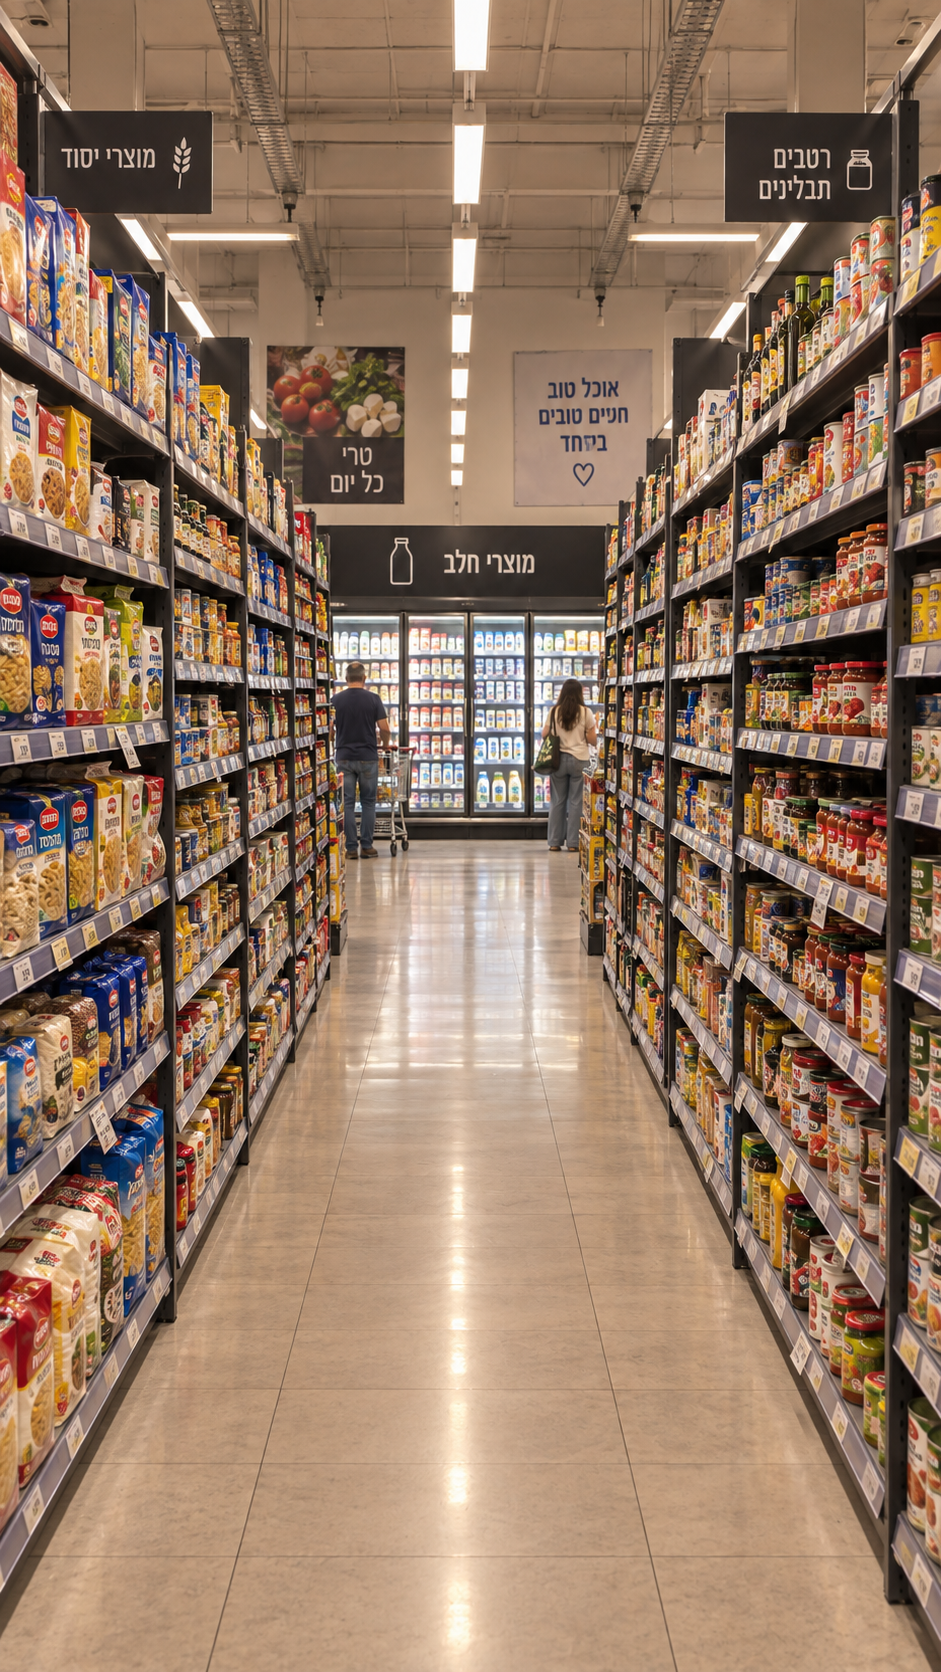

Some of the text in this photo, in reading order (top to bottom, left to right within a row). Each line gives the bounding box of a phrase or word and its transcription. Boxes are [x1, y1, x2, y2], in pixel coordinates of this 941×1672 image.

[60, 147, 156, 169] מוצרי יסוד
[773, 148, 831, 170] רטבים
[758, 174, 831, 200] תבלינים
[547, 376, 619, 399] אוכל טוב
[538, 407, 583, 426] טובים
[342, 446, 373, 466] טרי
[330, 469, 384, 494] כל יום
[443, 548, 535, 574] מוצרי חלב
